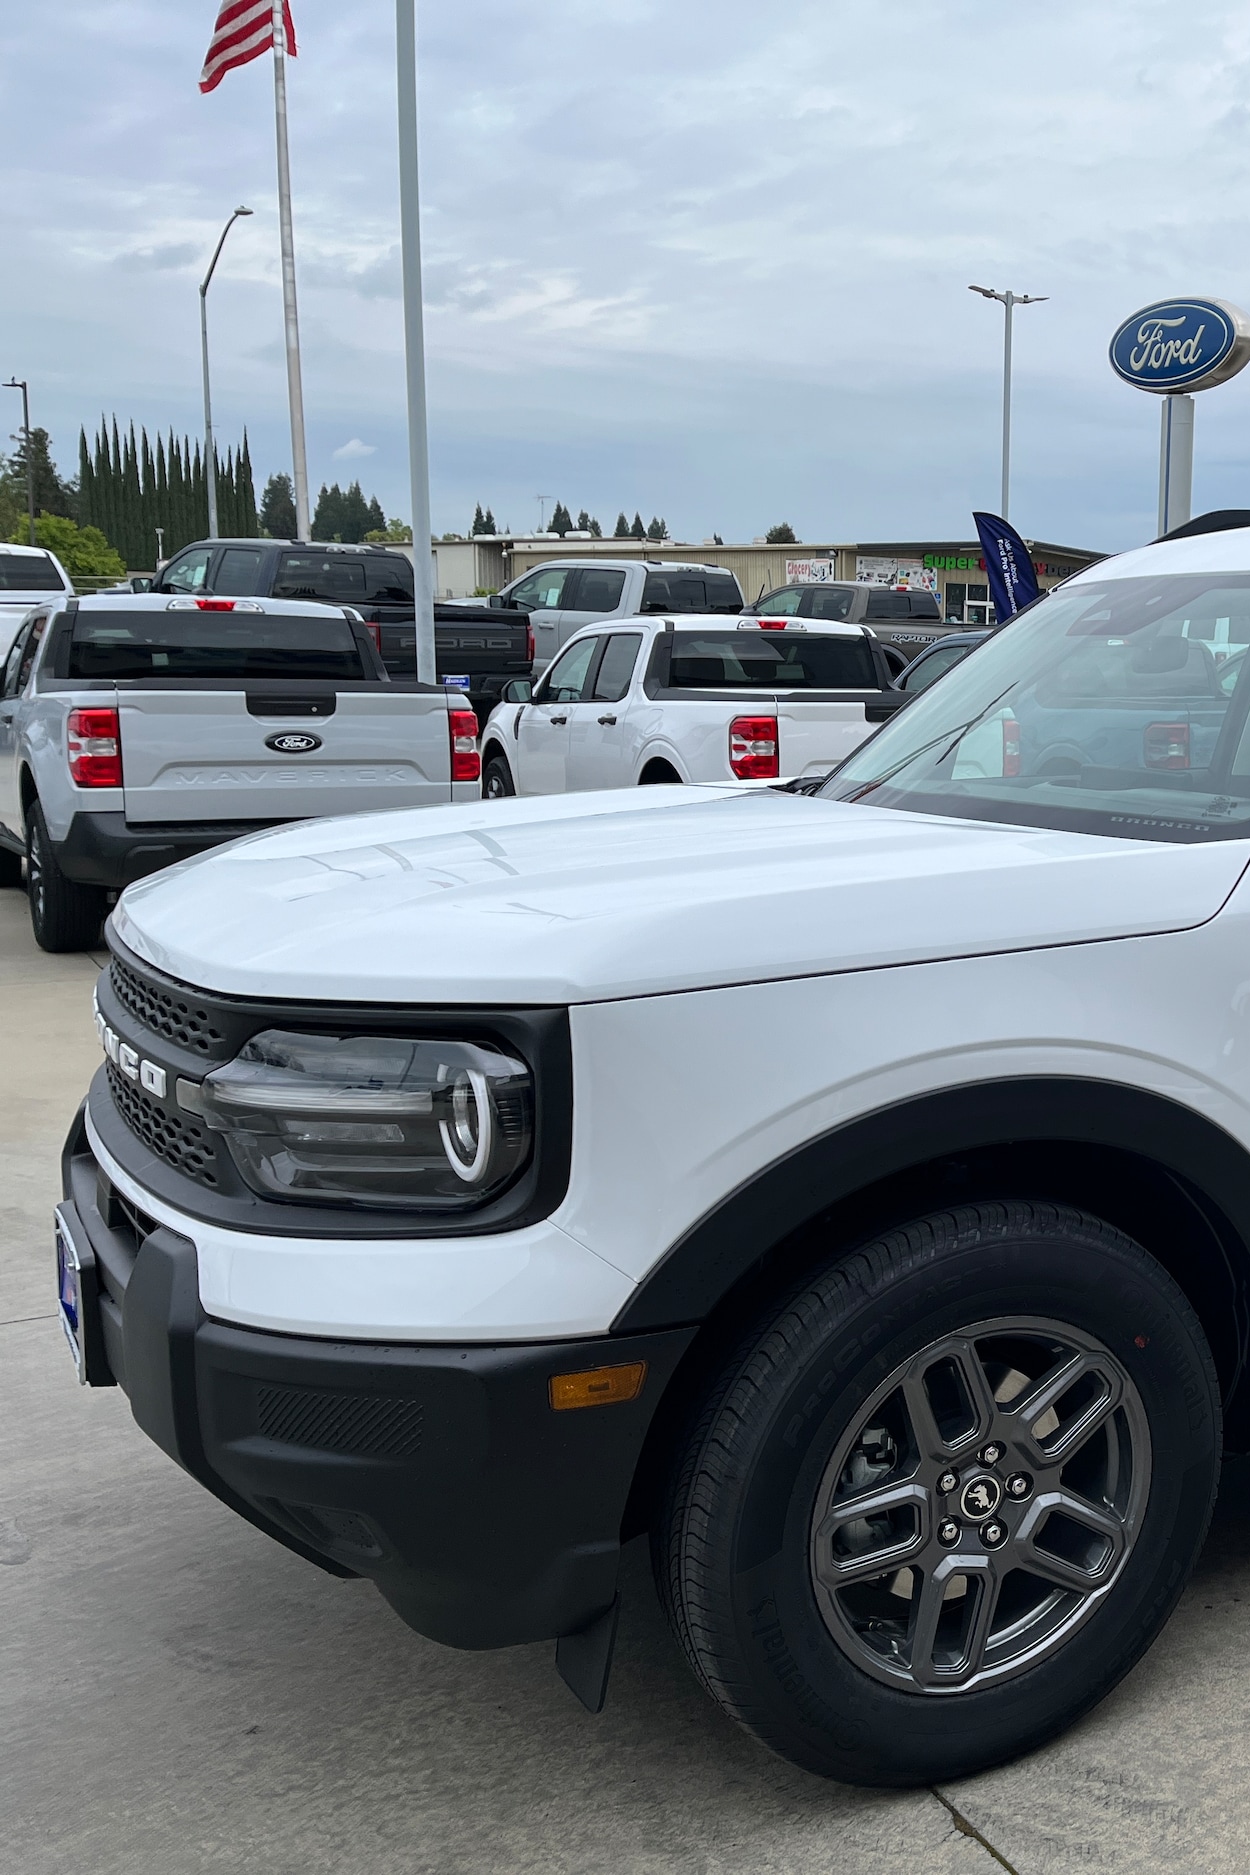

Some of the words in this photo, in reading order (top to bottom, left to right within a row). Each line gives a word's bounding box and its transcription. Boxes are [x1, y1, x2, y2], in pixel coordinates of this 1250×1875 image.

[1130, 315, 1206, 372] Ford
[923, 553, 976, 571] Super
[1007, 551, 1014, 562] Us
[788, 562, 811, 577] Grocery
[997, 539, 1007, 556] Ford
[1004, 572, 1018, 614] Intelligence
[1010, 562, 1019, 584] About
[891, 633, 938, 645] RAPTOR
[175, 769, 408, 786] MAVERICK
